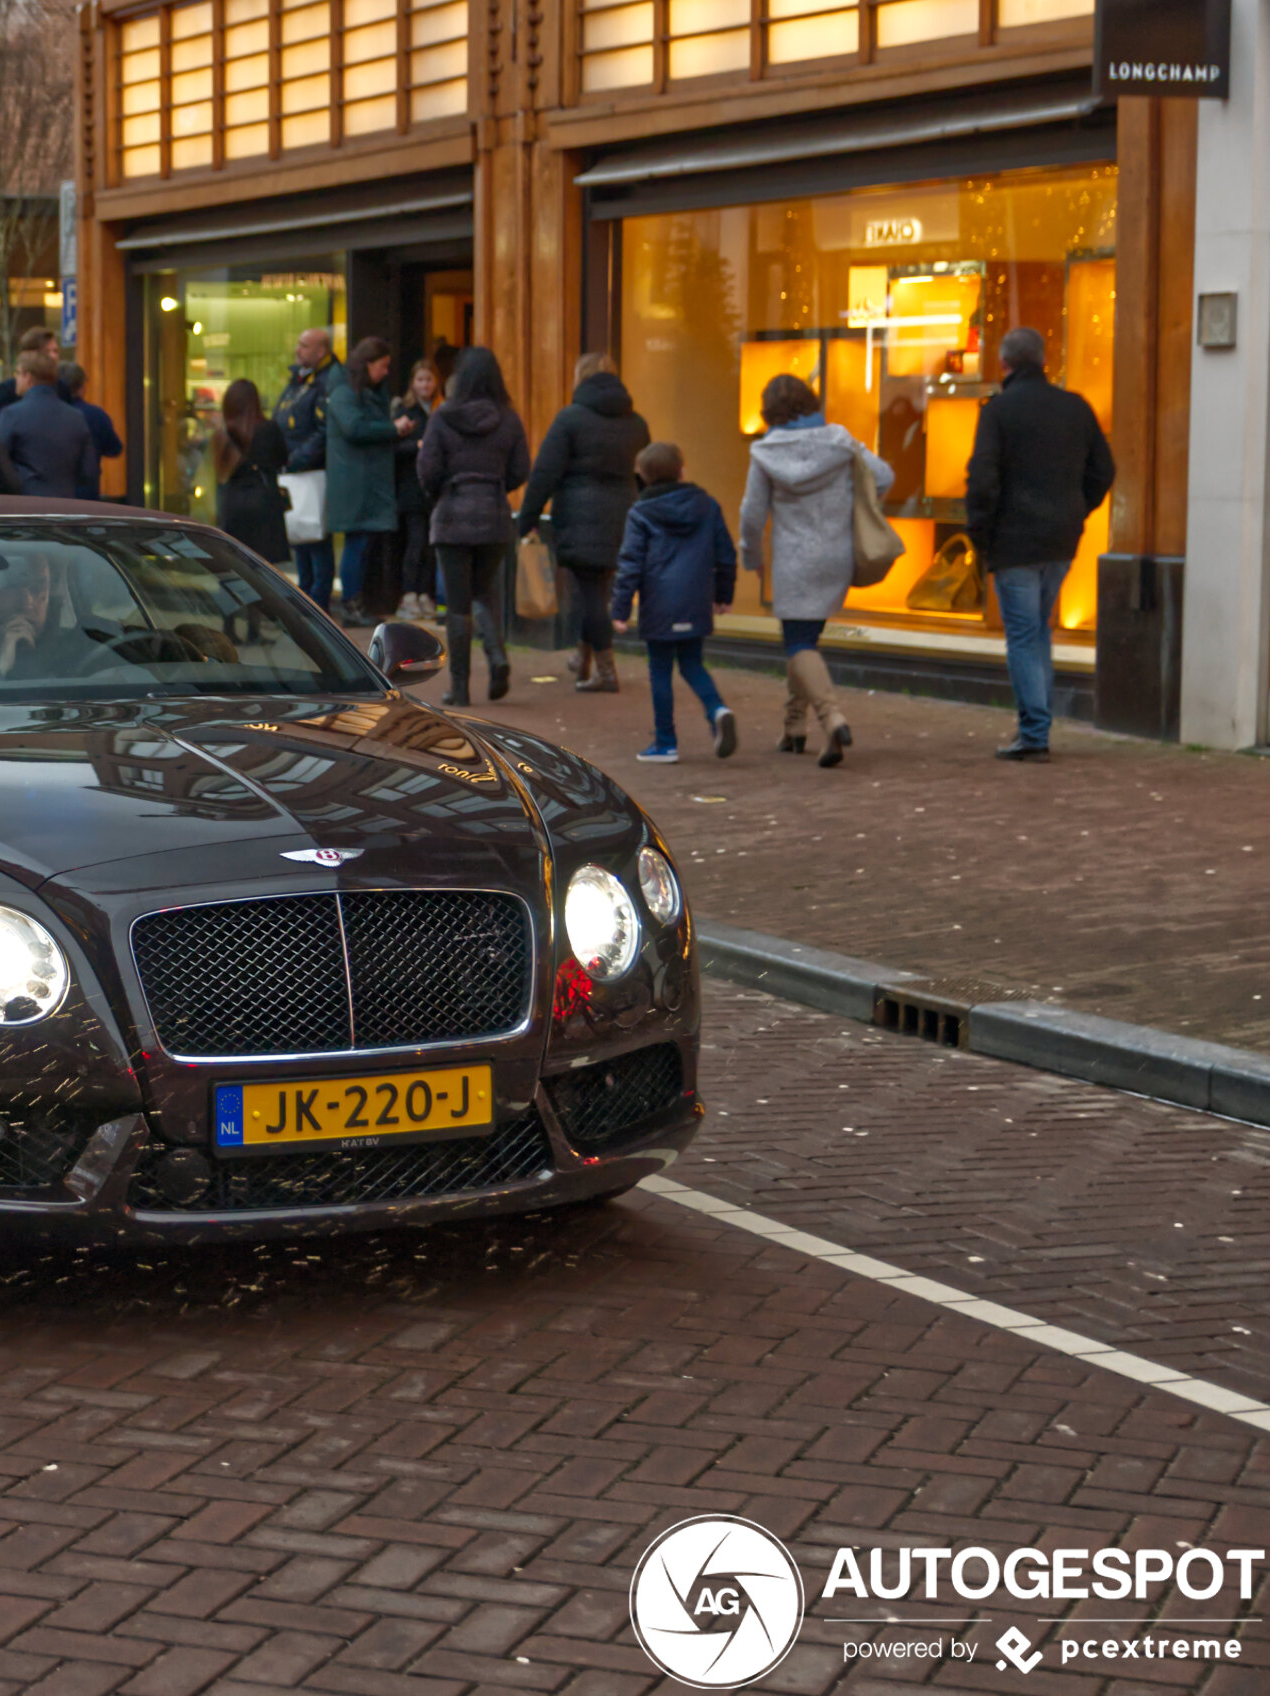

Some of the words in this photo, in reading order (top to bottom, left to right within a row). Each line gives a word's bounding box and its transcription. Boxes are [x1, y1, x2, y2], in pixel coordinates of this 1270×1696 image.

[1109, 62, 1221, 82] LONGCHAMP
[265, 1075, 470, 1135] JK-220-J
[220, 1122, 240, 1136] NL
